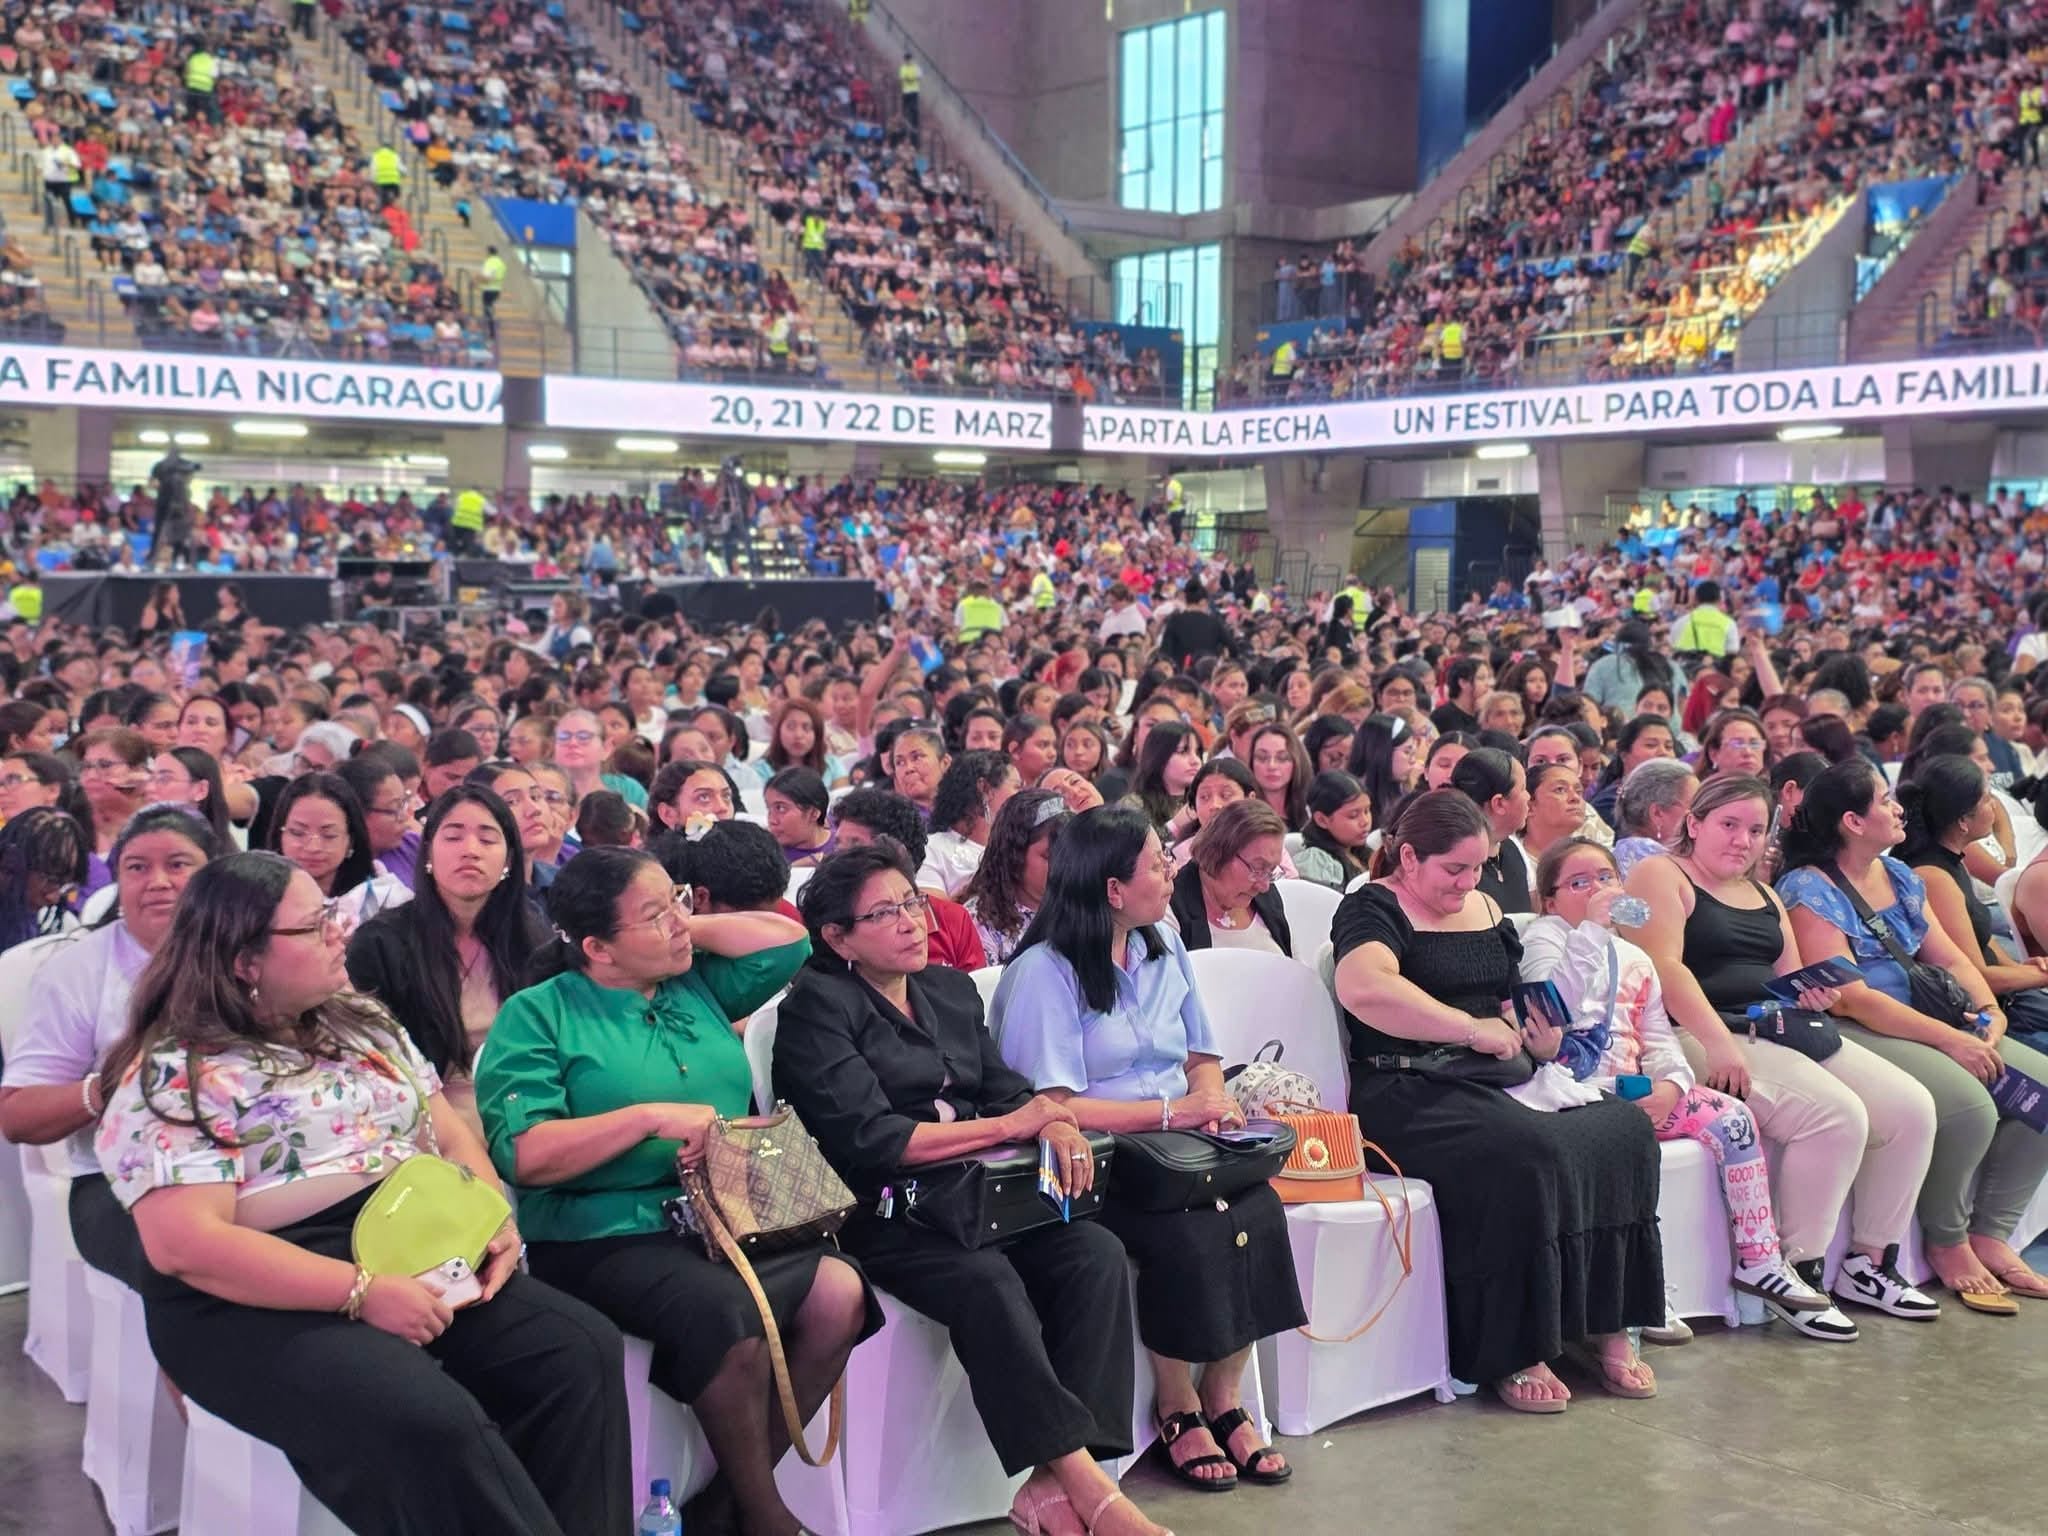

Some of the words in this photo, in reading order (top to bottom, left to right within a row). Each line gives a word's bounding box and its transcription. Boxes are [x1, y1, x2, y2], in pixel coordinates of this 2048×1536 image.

[46, 359, 241, 400] FAMILIA
[1394, 406, 1434, 435] UN
[1446, 396, 1593, 431] FESTIVAL
[1605, 388, 1699, 422] PARA
[1711, 380, 1818, 415] TODA
[1832, 375, 1882, 407] LA
[1896, 362, 2048, 404] FAMILI
[711, 396, 762, 432] 20,
[773, 399, 802, 428] 21
[814, 402, 834, 429] Y
[845, 403, 880, 432] 22
[893, 406, 934, 434] DE
[956, 410, 1050, 439] MARZ
[1202, 420, 1233, 446] LA
[1243, 414, 1330, 444] FECHA
[1728, 1166, 1754, 1183] GOOD
[1730, 1185, 1750, 1202] ARE
